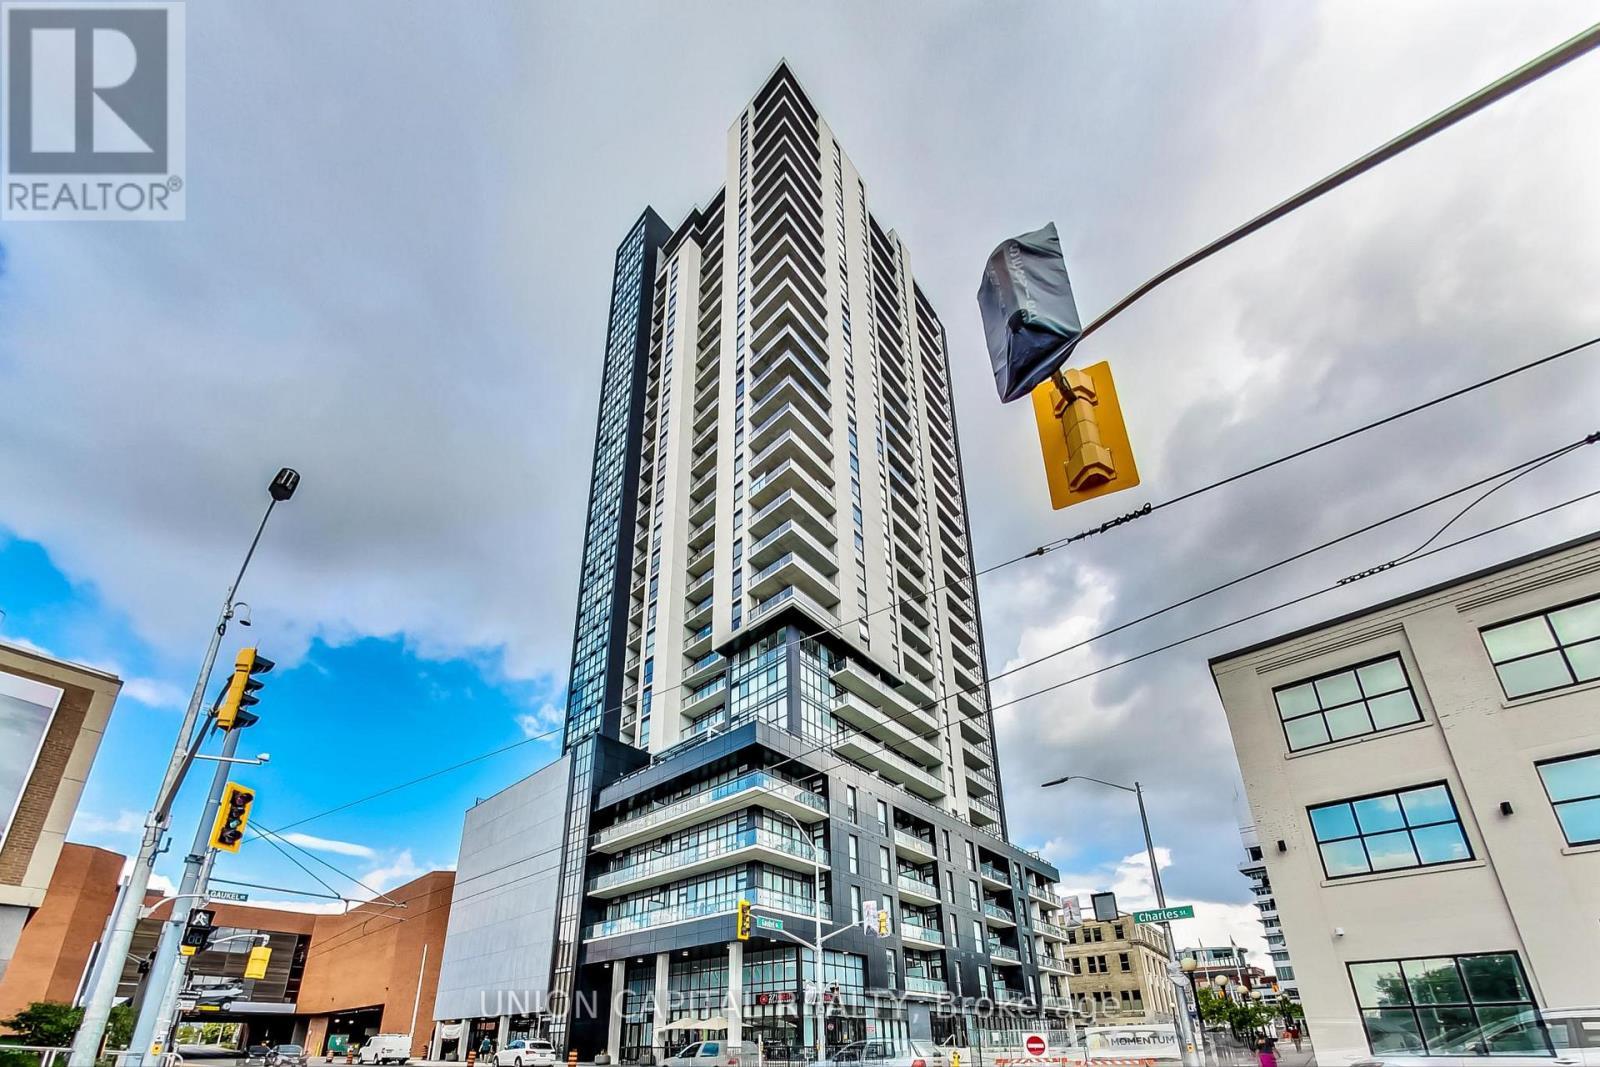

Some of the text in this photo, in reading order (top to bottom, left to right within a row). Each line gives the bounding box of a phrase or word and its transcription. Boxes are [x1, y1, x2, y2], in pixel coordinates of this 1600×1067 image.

[210, 891, 240, 901] GAUKEL
[1139, 910, 1179, 922] Charles
[1111, 1035, 1175, 1046] MOMENTUM
